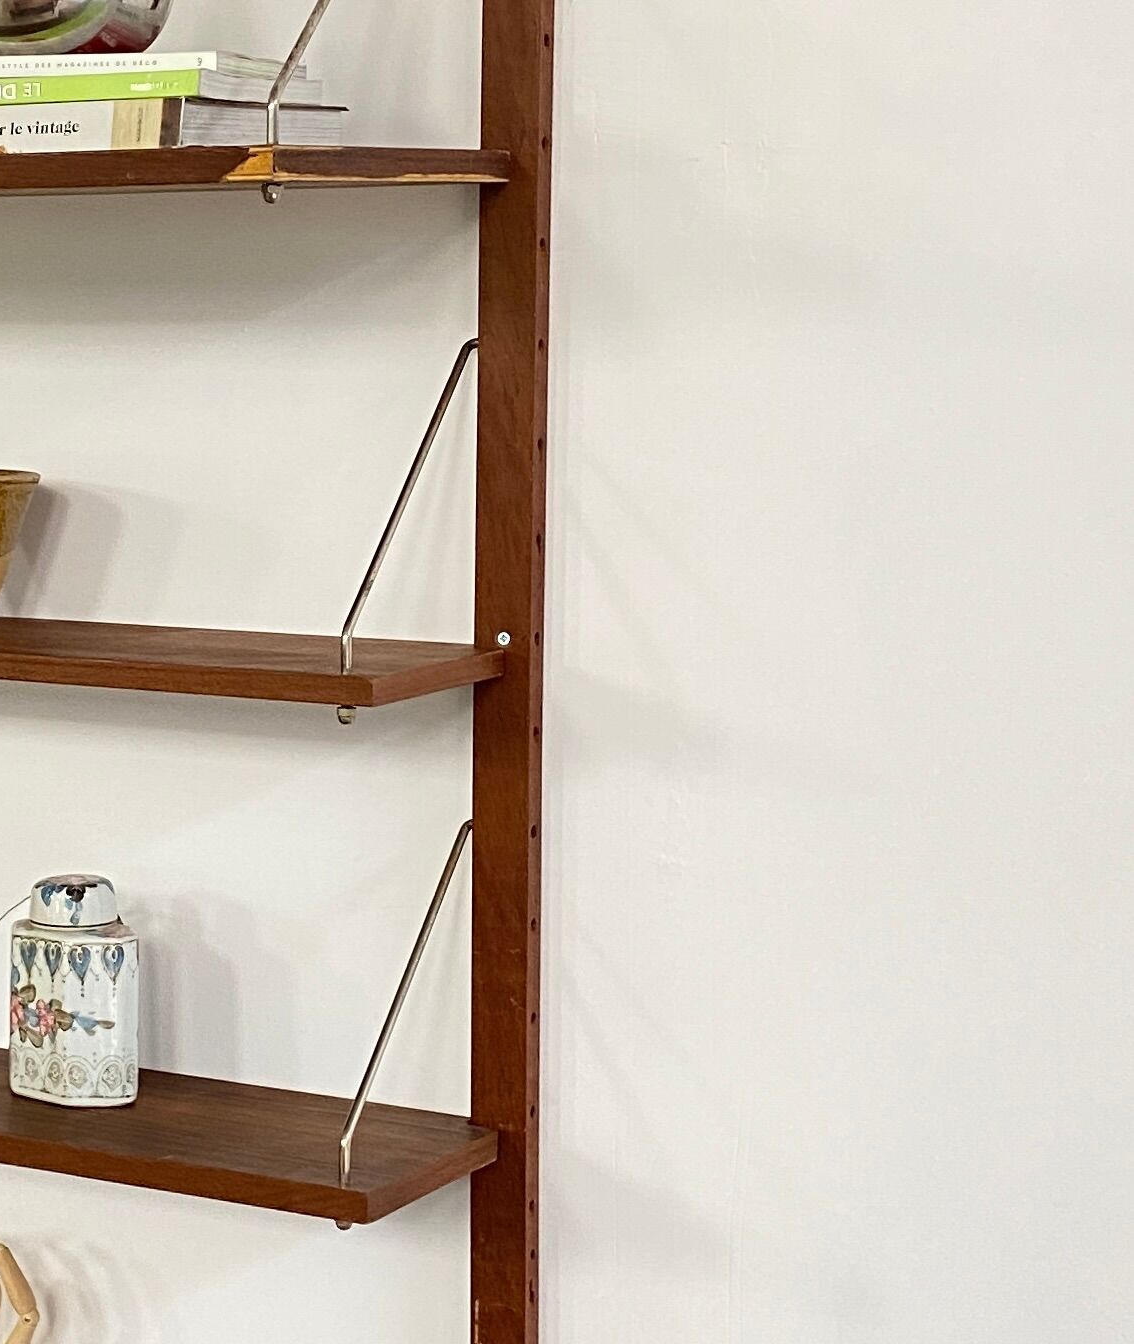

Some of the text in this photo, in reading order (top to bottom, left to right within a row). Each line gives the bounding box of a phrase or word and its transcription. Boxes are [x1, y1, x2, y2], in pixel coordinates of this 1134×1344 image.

[56, 60, 110, 68] MAGAZINES
[23, 82, 42, 98] LE
[10, 122, 23, 136] le
[26, 120, 80, 137] vintage
